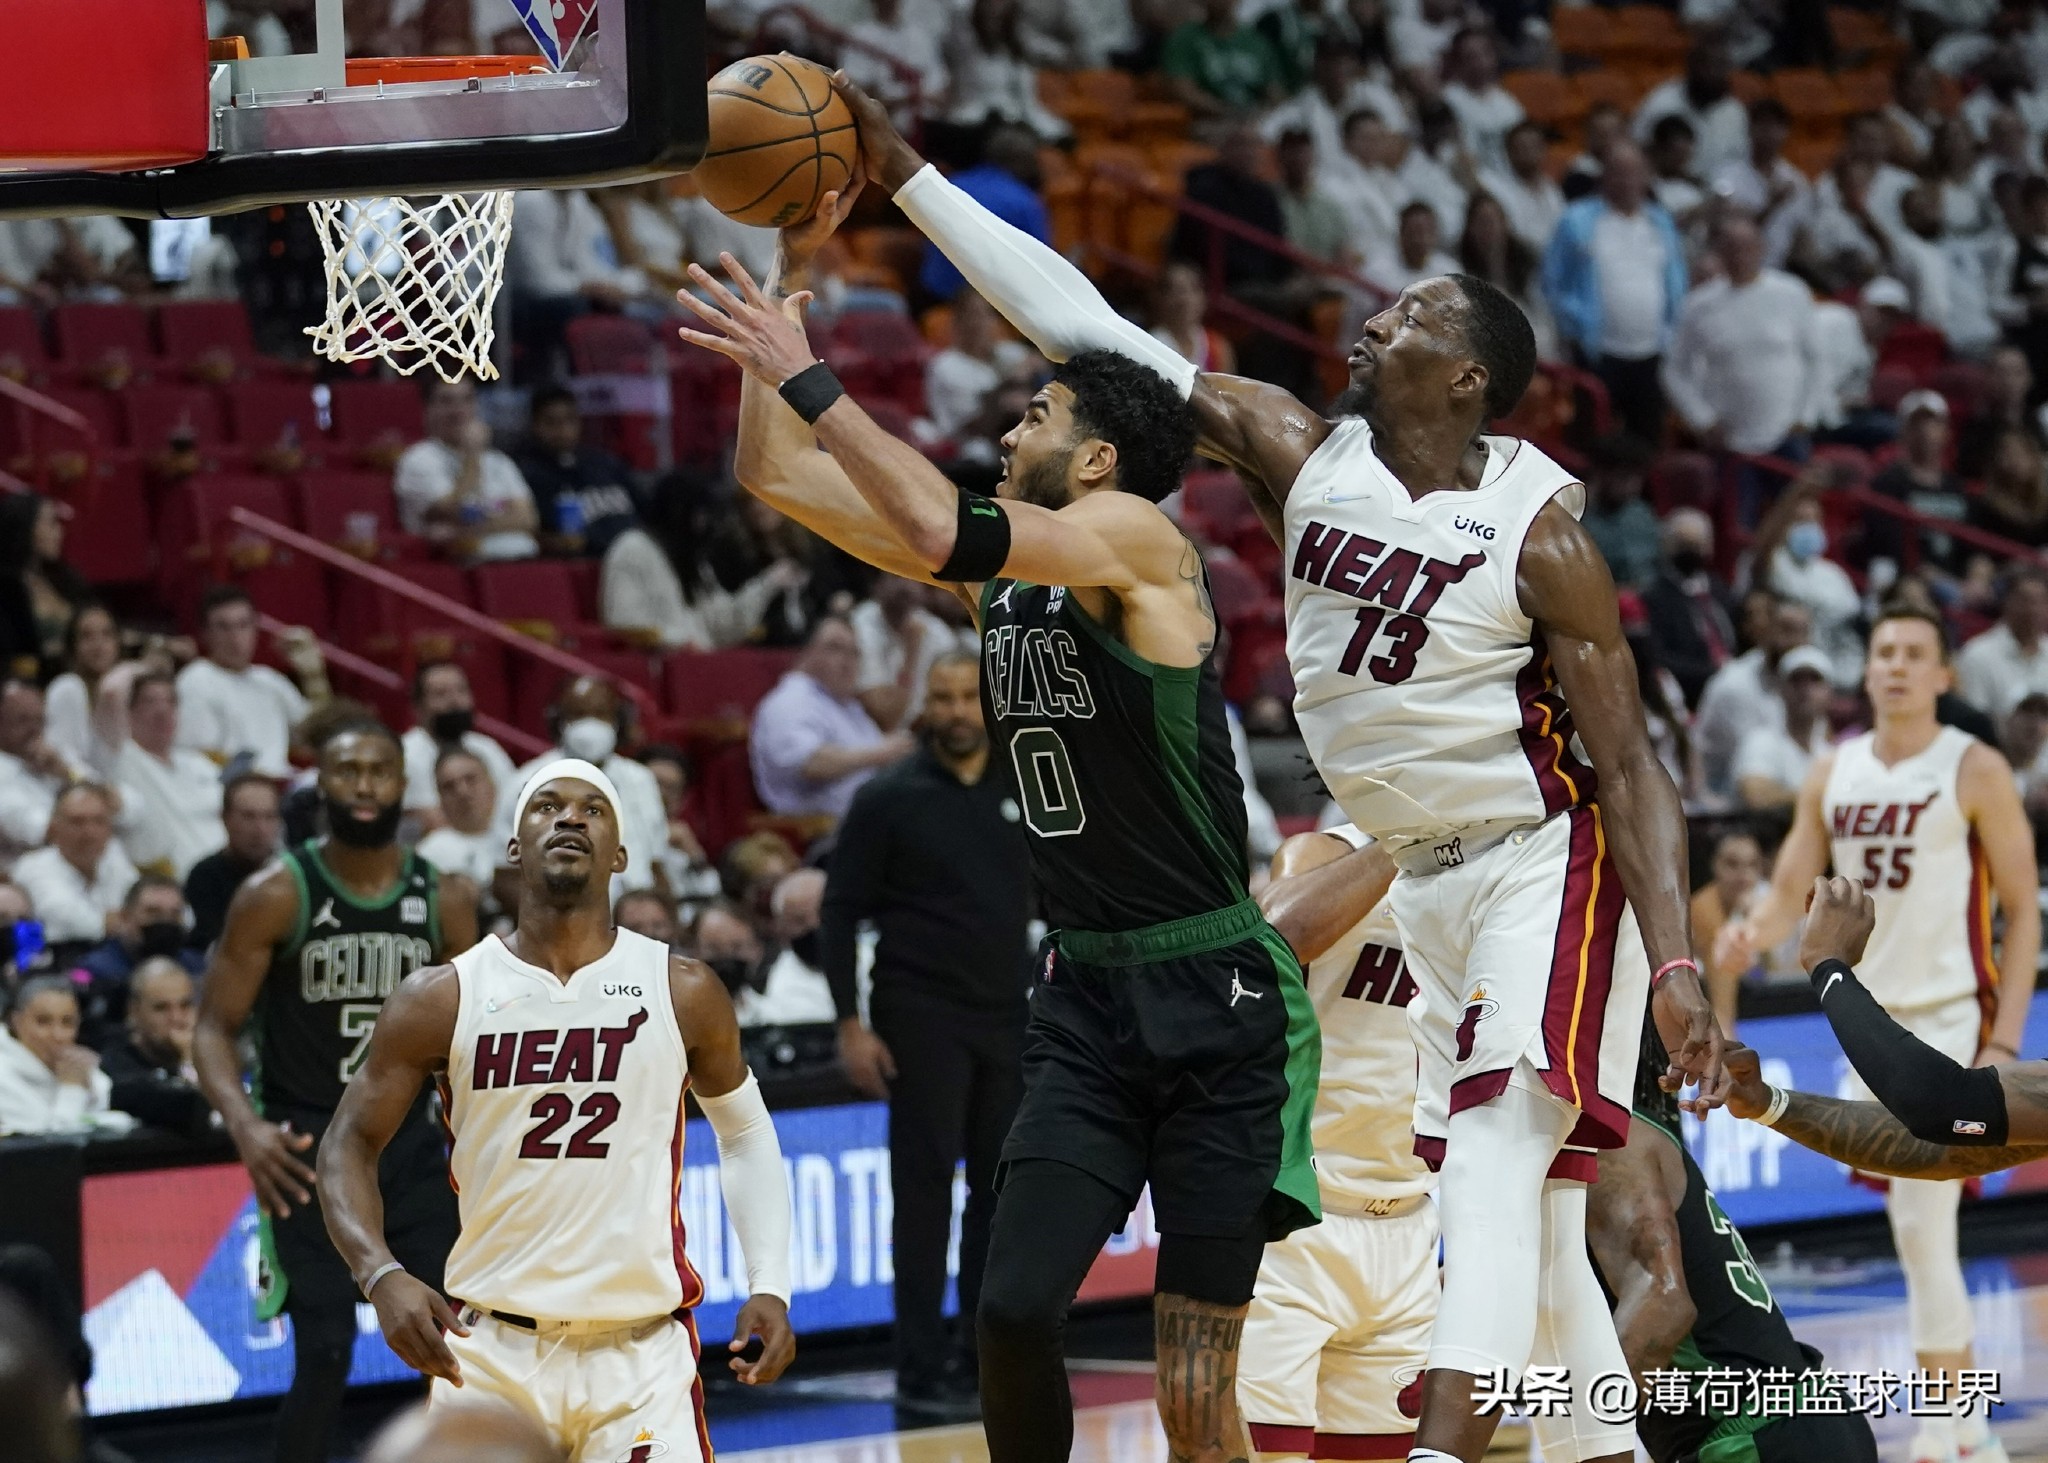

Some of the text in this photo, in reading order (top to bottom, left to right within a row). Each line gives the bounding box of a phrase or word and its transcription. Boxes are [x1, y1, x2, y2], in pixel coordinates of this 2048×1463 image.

[1292, 521, 1487, 618] HEAT
[1337, 606, 1430, 686] 13
[1010, 726, 1087, 838] 0
[1833, 787, 1941, 838] HEAT
[1862, 847, 1915, 889] 55
[473, 1005, 649, 1091] HEAT
[518, 1092, 622, 1159] 22
